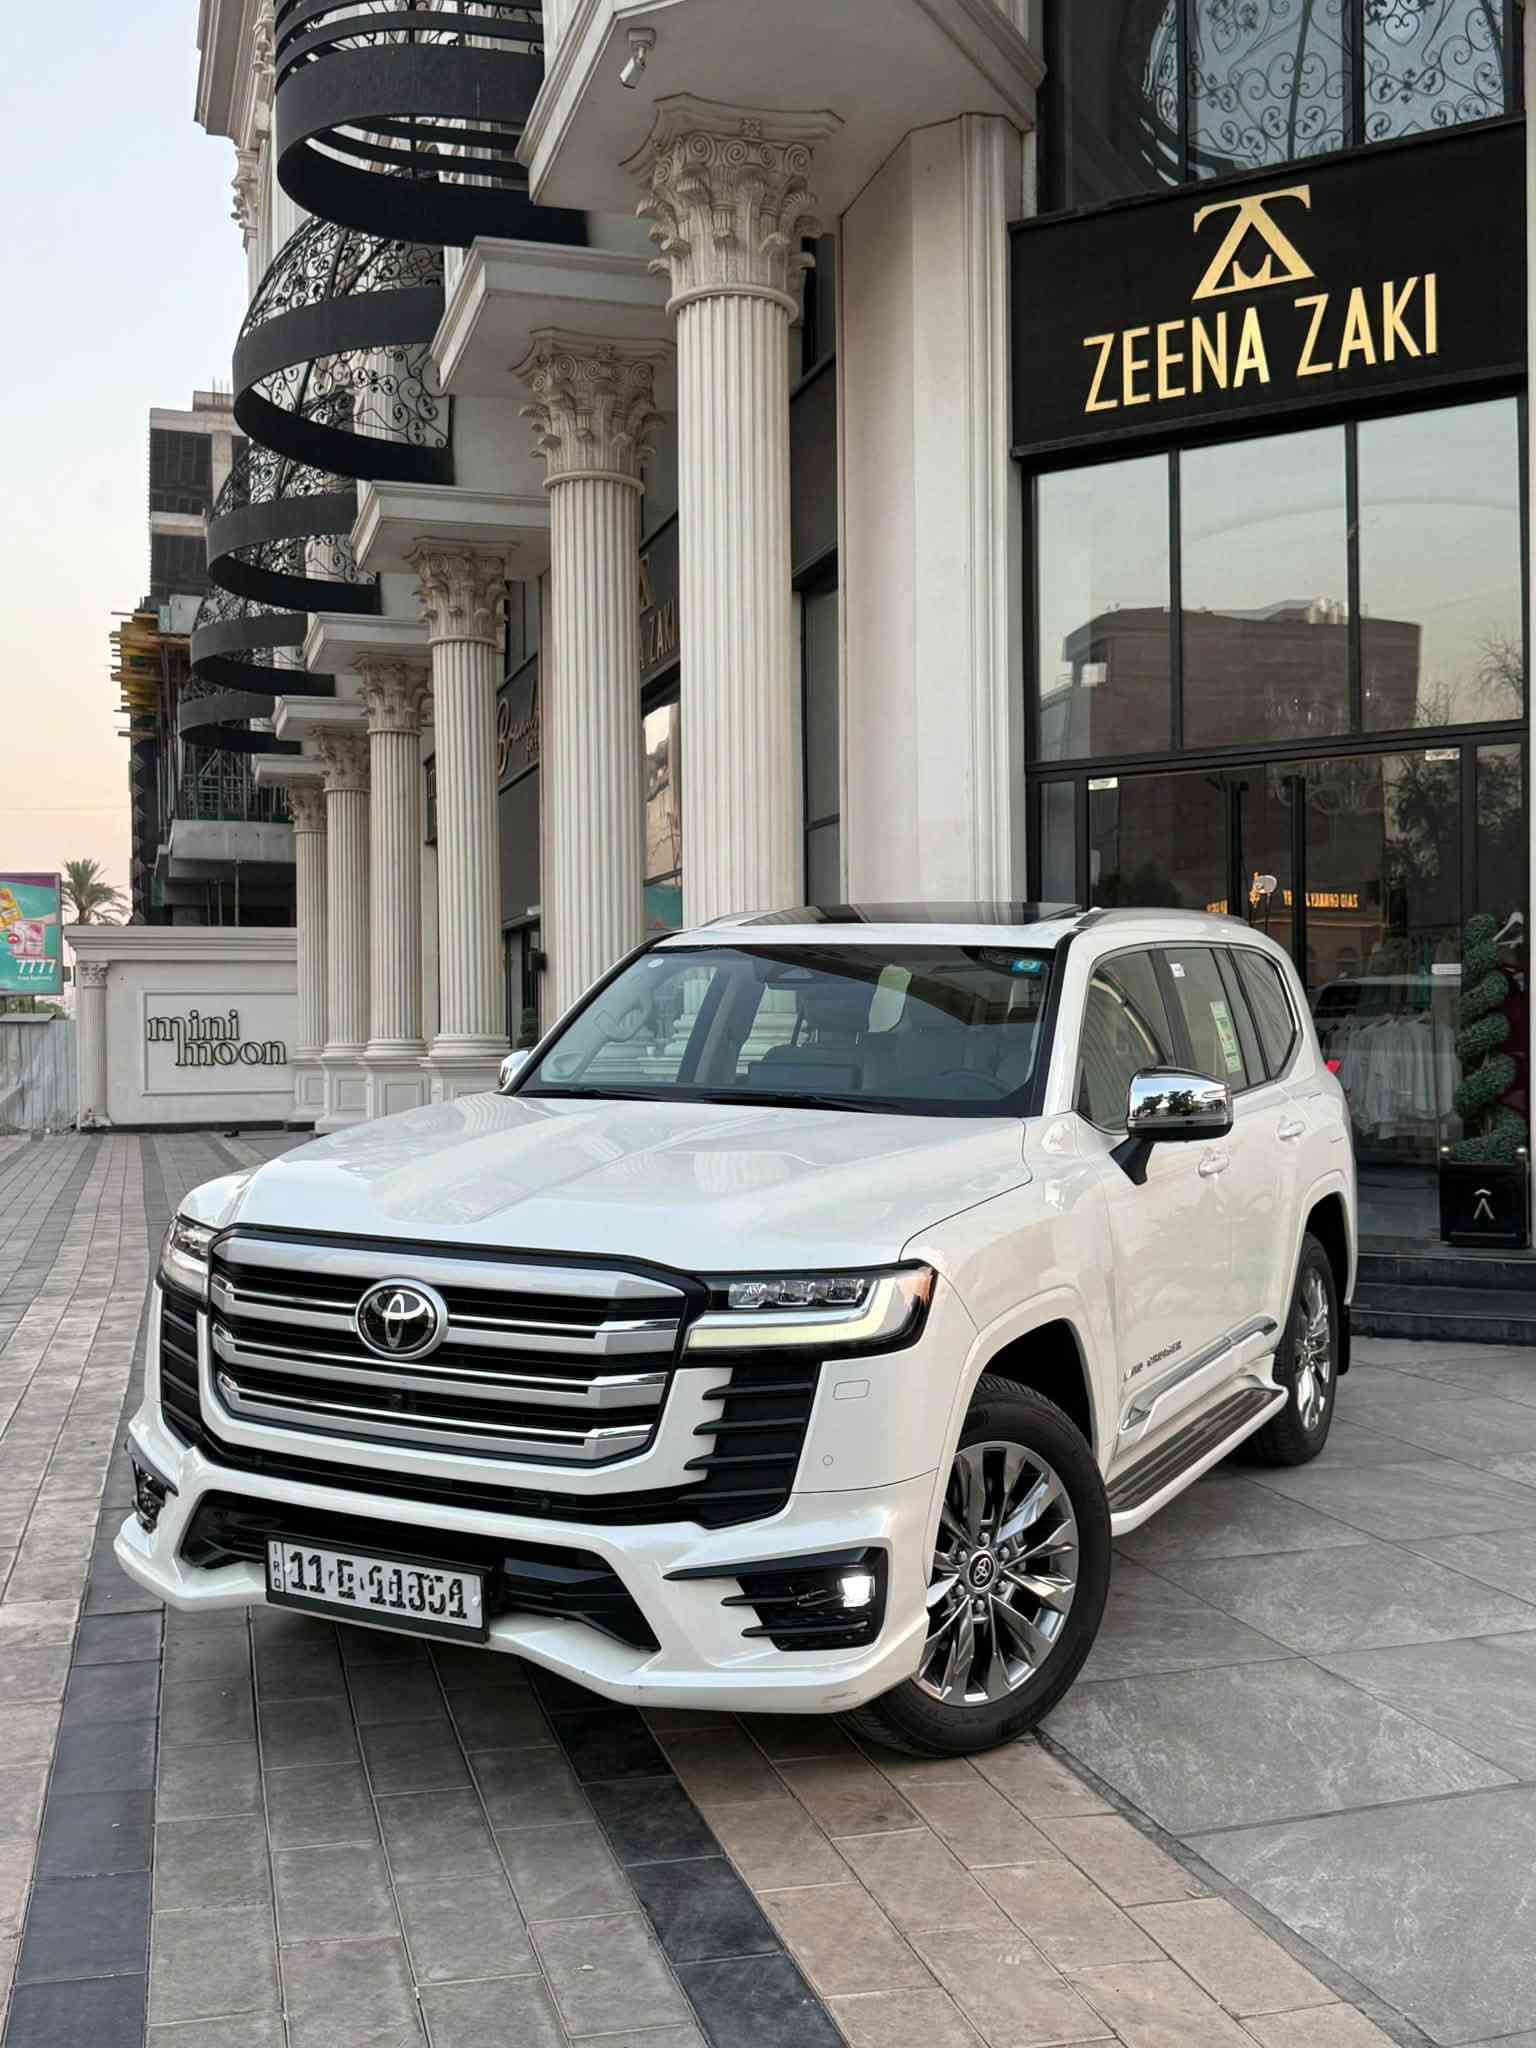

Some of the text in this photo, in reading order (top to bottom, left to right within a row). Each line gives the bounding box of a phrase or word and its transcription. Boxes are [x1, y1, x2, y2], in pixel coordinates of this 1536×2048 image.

[1083, 273, 1438, 413] ZEENA ZAKI
[16, 959, 56, 975] 7777
[147, 1010, 240, 1041] mini
[176, 1040, 287, 1066] moon
